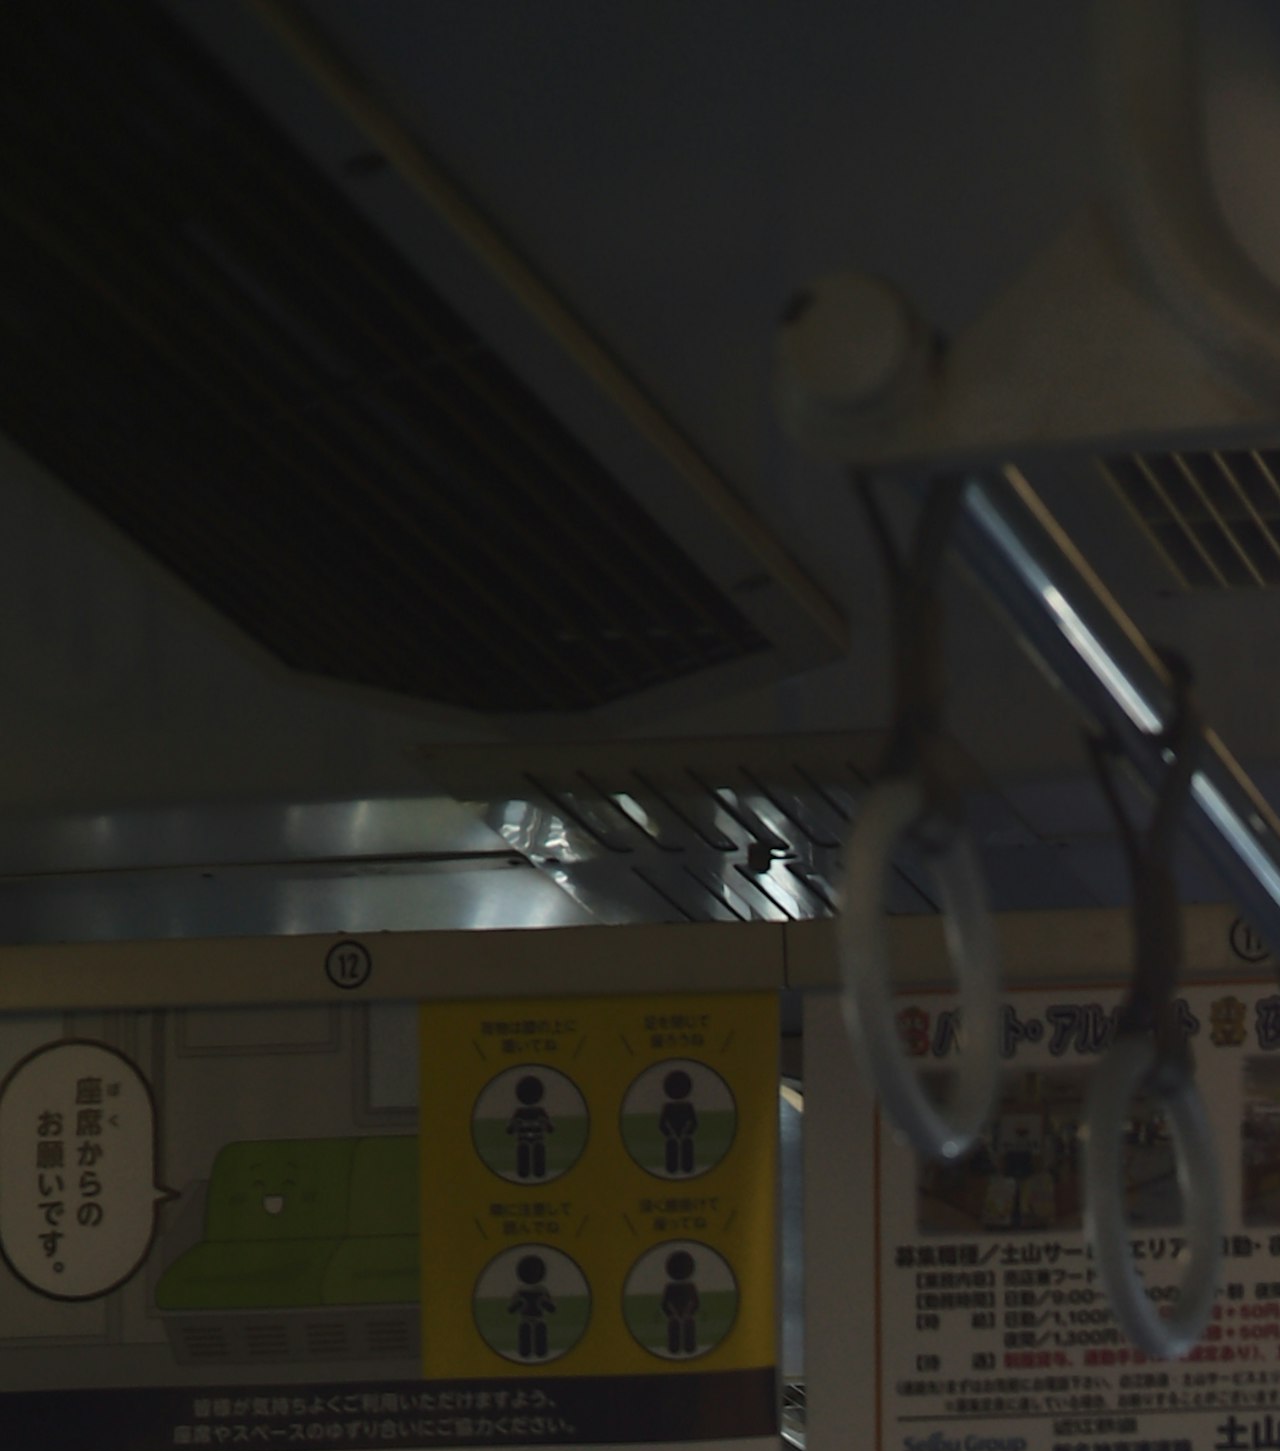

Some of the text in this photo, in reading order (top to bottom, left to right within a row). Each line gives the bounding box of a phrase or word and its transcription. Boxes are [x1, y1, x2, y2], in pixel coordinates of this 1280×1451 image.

[338, 953, 358, 978] 12
[36, 1109, 66, 1274] お願いです。
[75, 1077, 104, 1227] 座席からの
